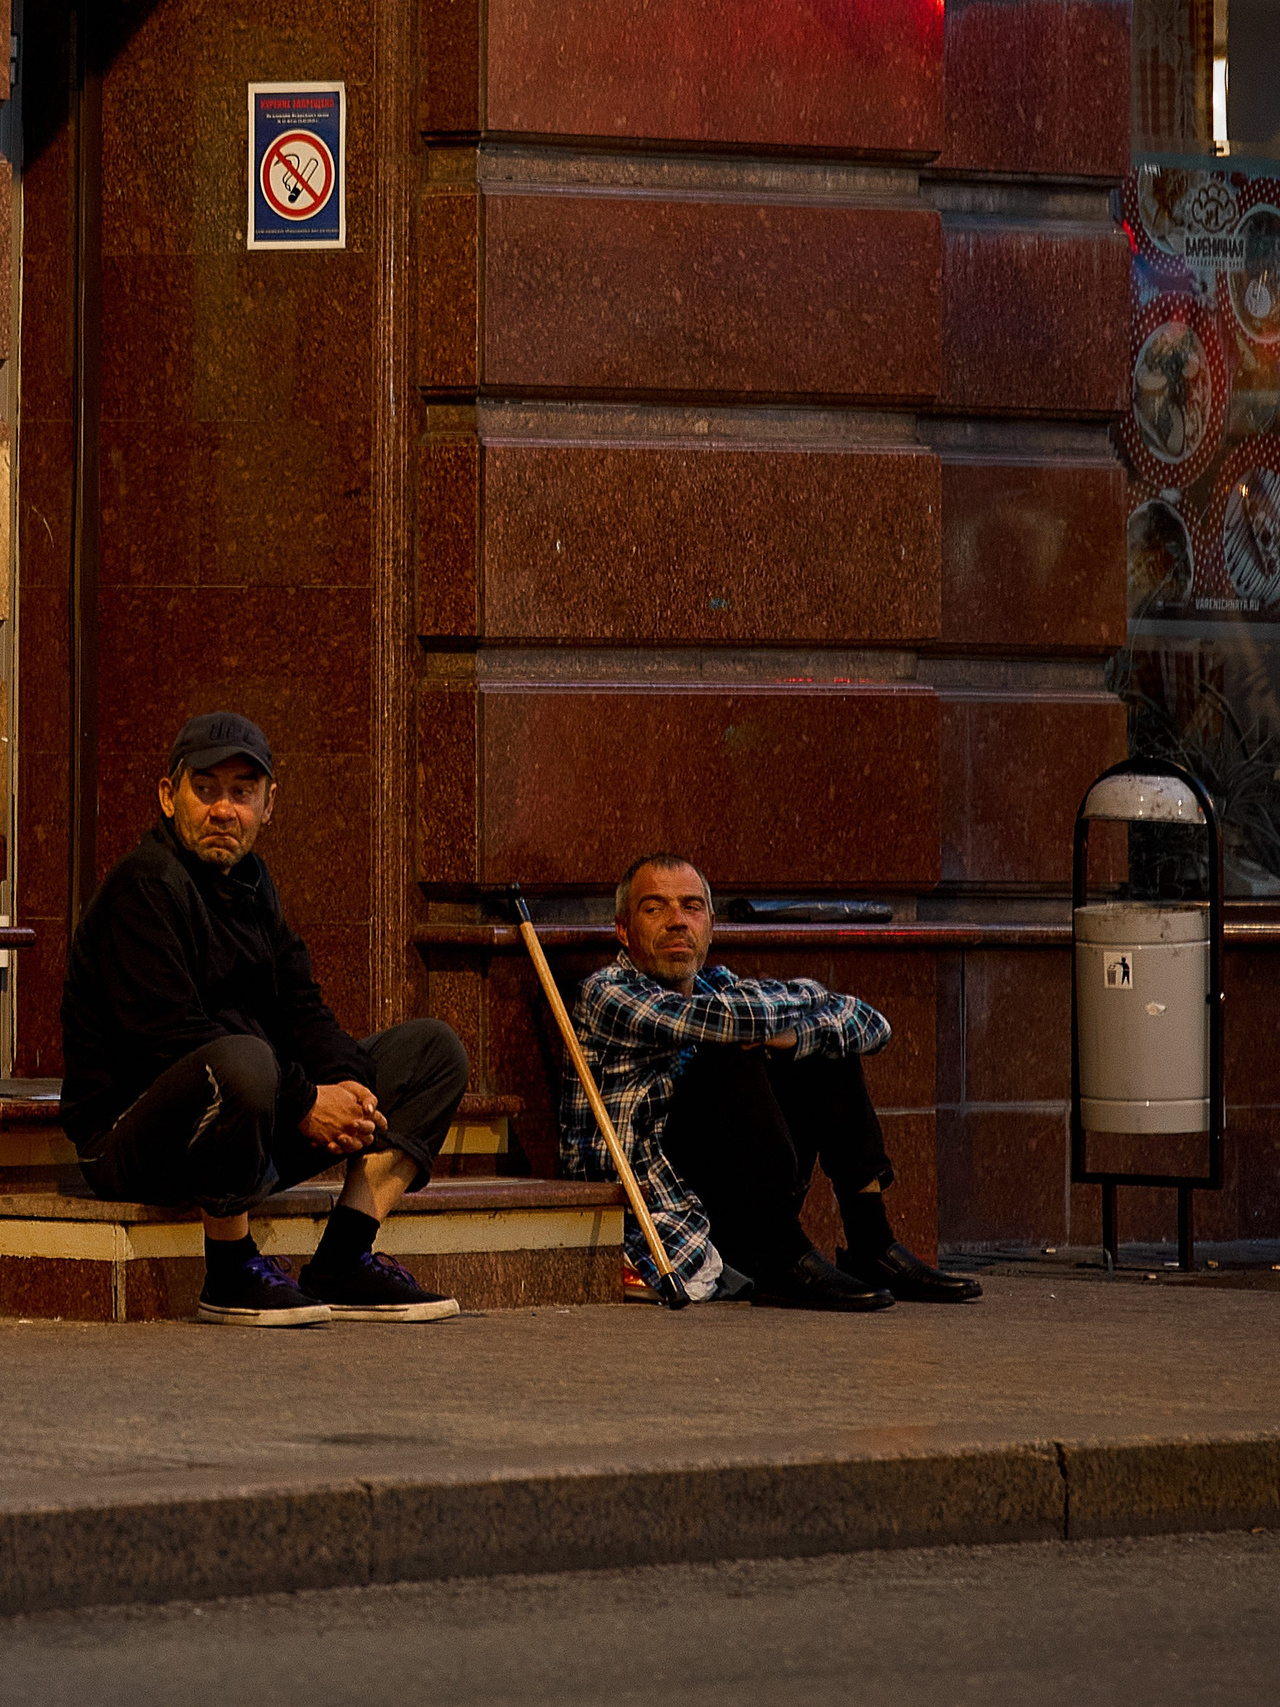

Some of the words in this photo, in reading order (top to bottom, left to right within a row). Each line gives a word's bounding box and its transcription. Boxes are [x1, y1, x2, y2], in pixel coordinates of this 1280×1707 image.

[292, 98, 335, 109] ЗАПРЕЩЕНО
[1185, 237, 1244, 258] ВАРЕНИЧНАЯ
[1195, 598, 1259, 611] VARENICHNAYA.RU
